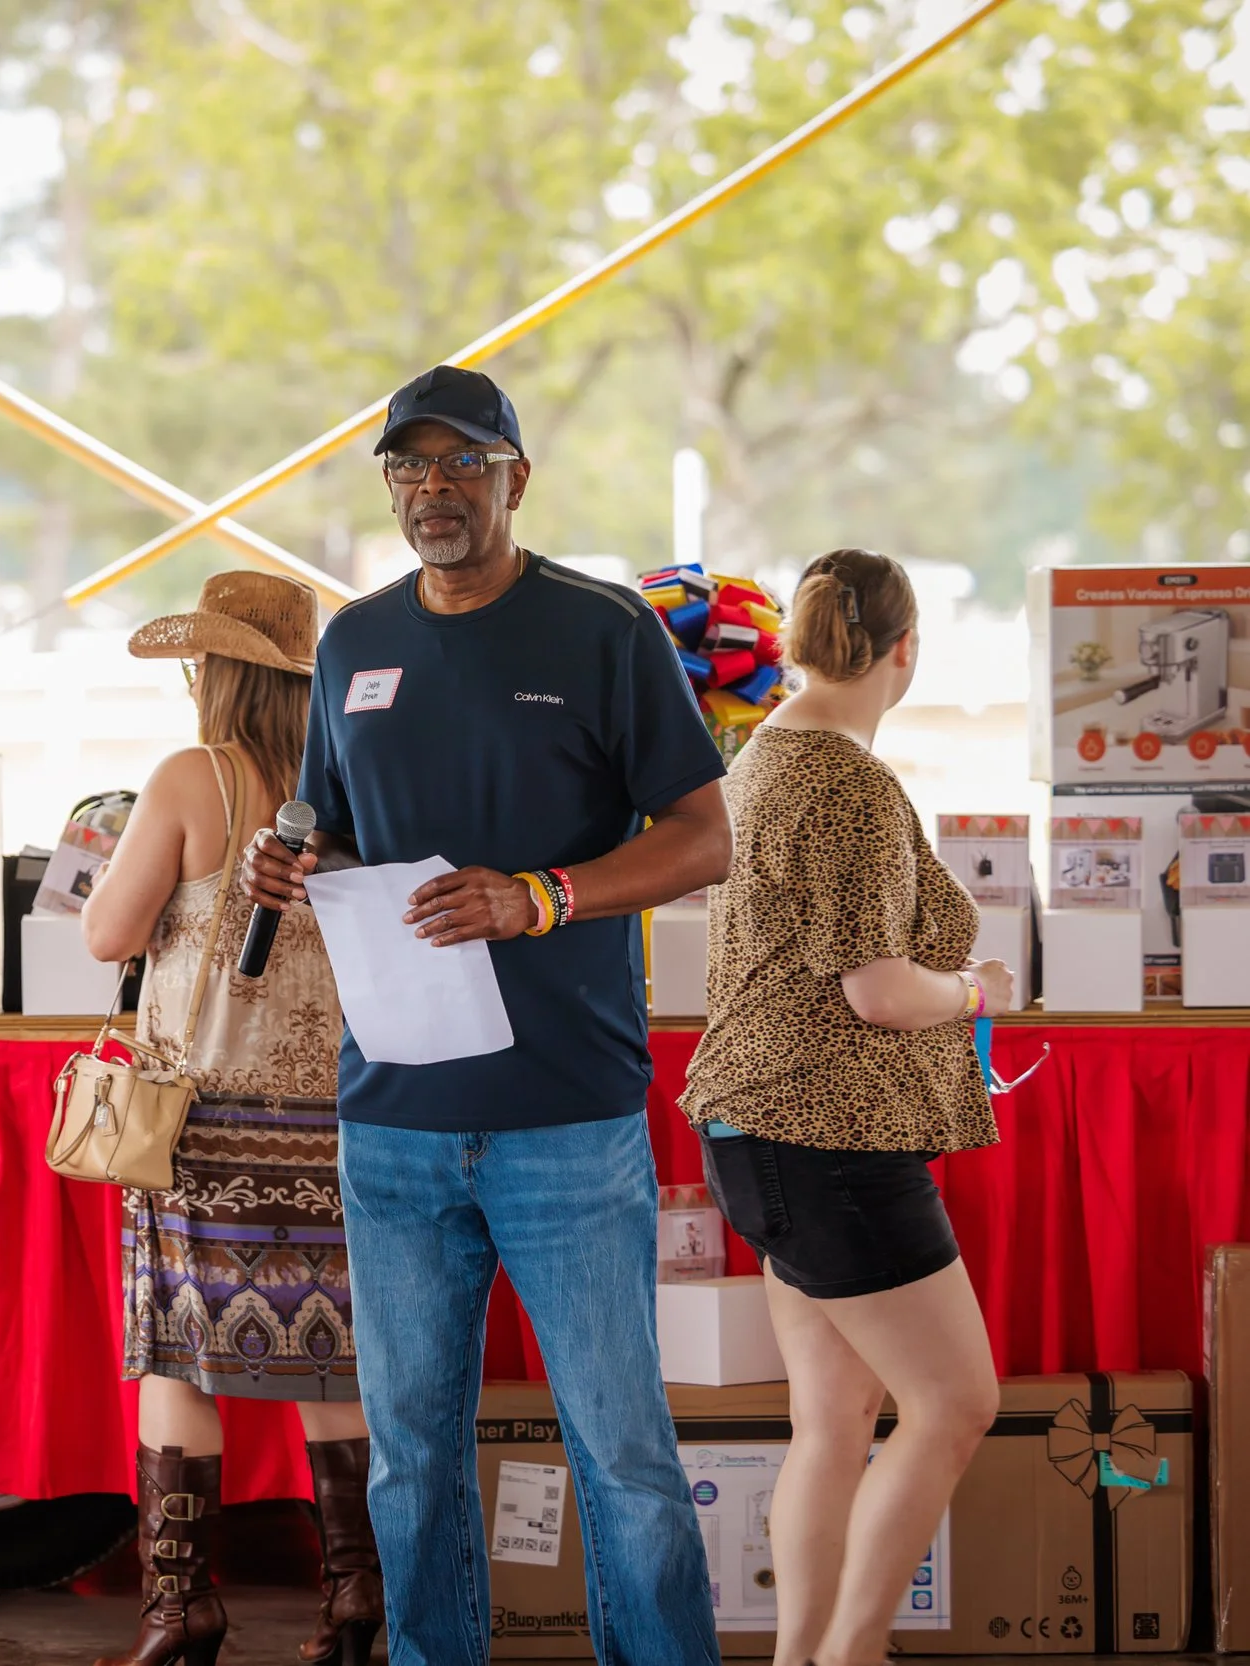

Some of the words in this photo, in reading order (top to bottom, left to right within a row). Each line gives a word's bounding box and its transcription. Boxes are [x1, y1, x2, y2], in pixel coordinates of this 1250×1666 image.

[1076, 588, 1124, 600] Creates
[1127, 587, 1174, 600] Various
[1176, 586, 1232, 602] Espresso
[514, 691, 542, 702] Calvin
[542, 694, 564, 705] Klein
[513, 1421, 557, 1442] Play
